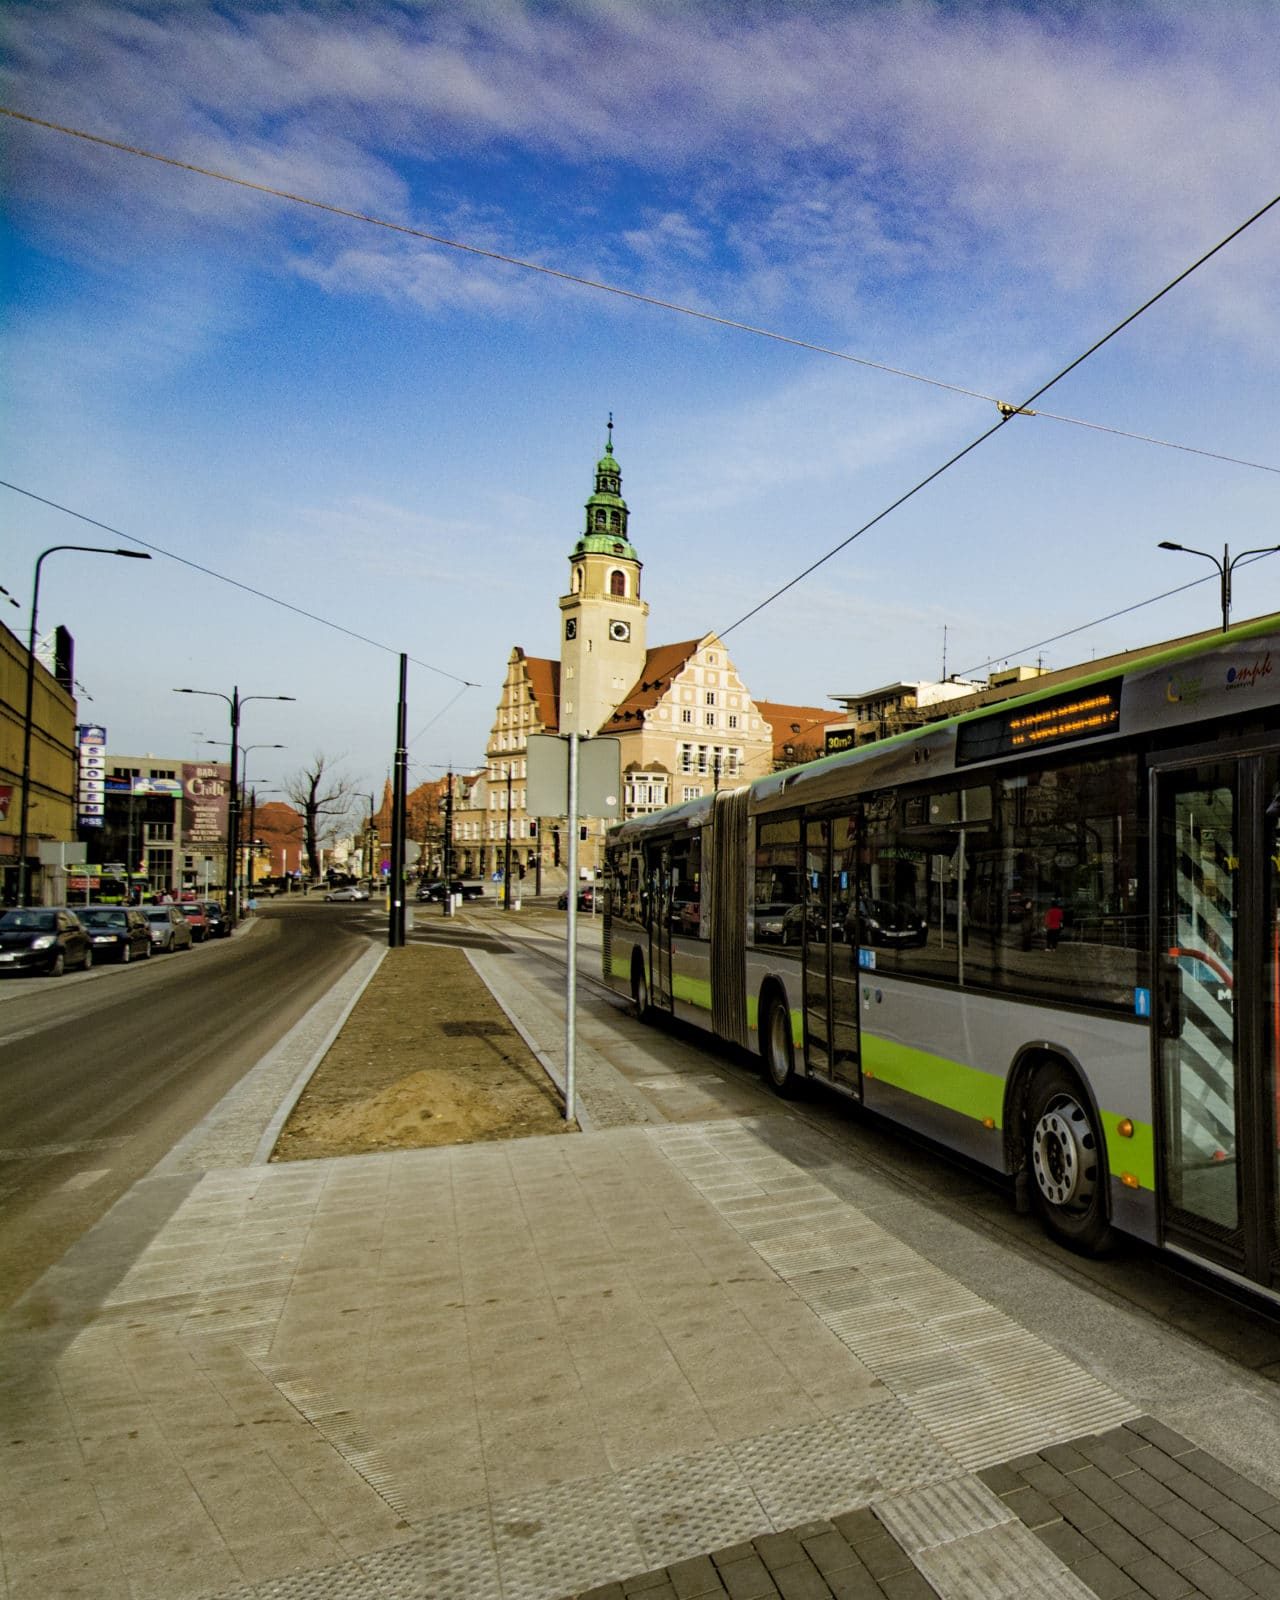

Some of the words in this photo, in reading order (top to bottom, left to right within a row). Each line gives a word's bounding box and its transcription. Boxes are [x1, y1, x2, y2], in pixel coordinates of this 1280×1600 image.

[1236, 651, 1273, 687] mpk
[85, 747, 99, 812] SPOŁEM
[81, 817, 102, 825] PSS
